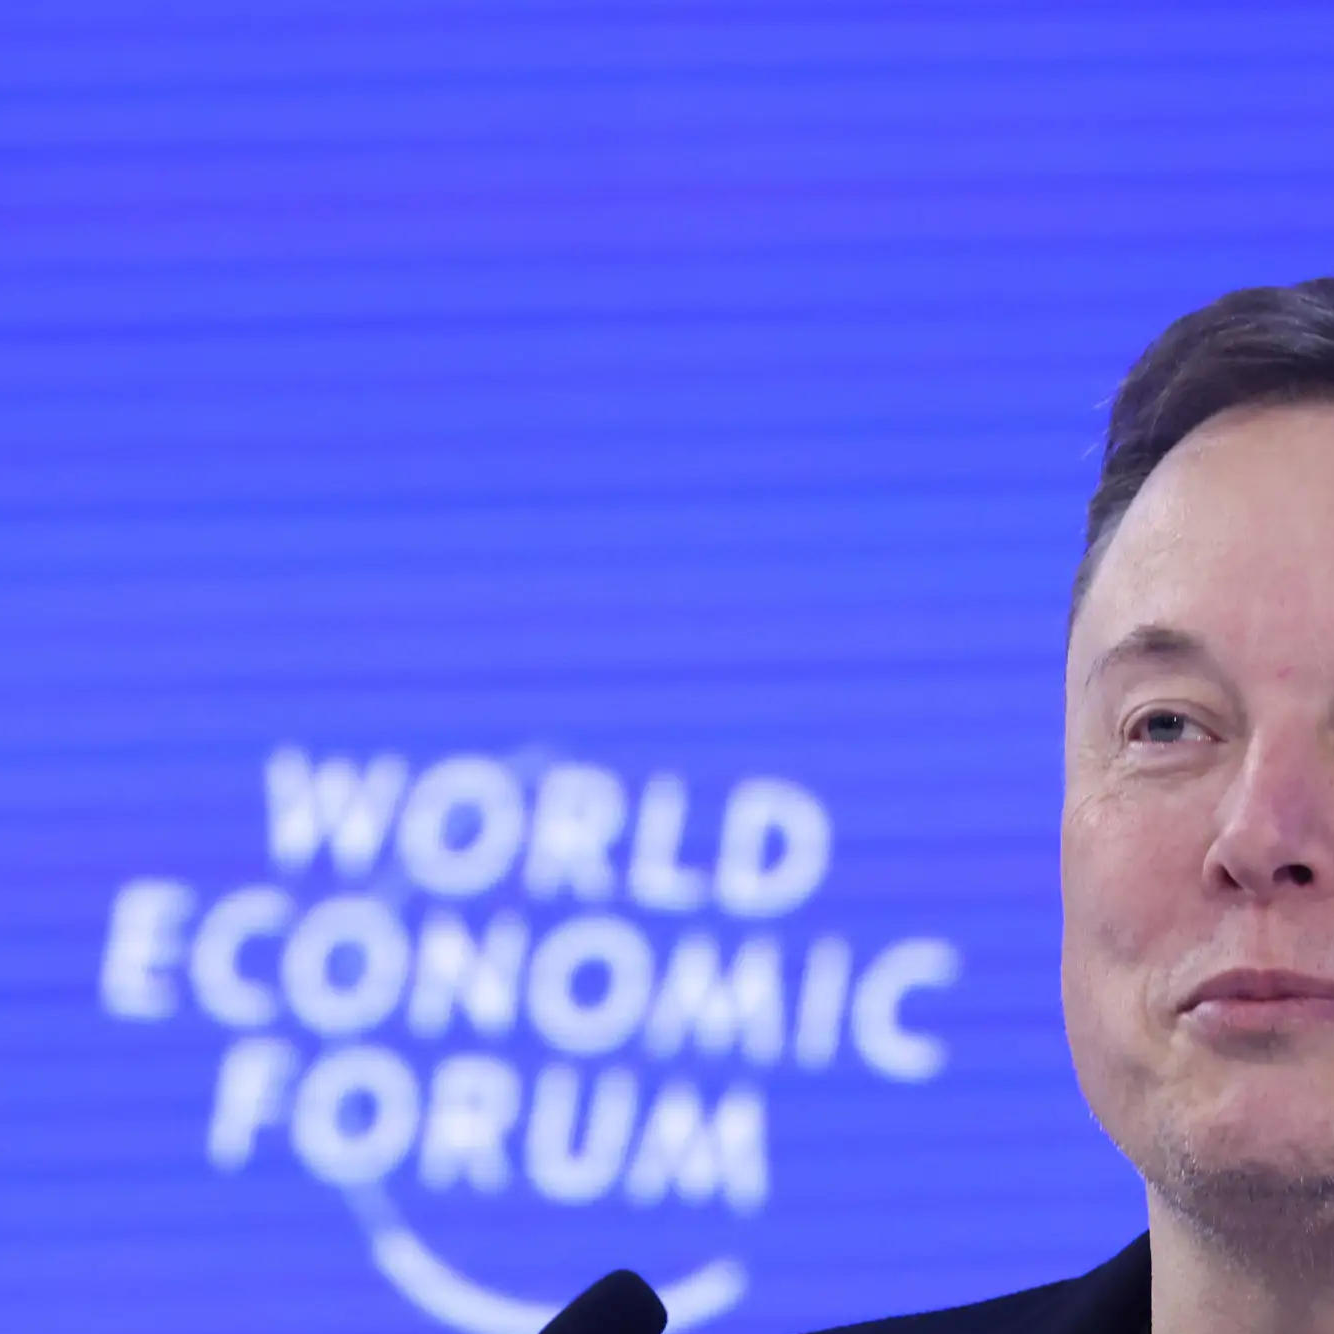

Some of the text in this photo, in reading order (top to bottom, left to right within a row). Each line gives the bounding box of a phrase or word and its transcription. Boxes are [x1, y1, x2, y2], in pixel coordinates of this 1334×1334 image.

[264, 746, 833, 918] WORLD
[99, 877, 960, 1082] ECONOMIC
[207, 1036, 769, 1215] FORUM
